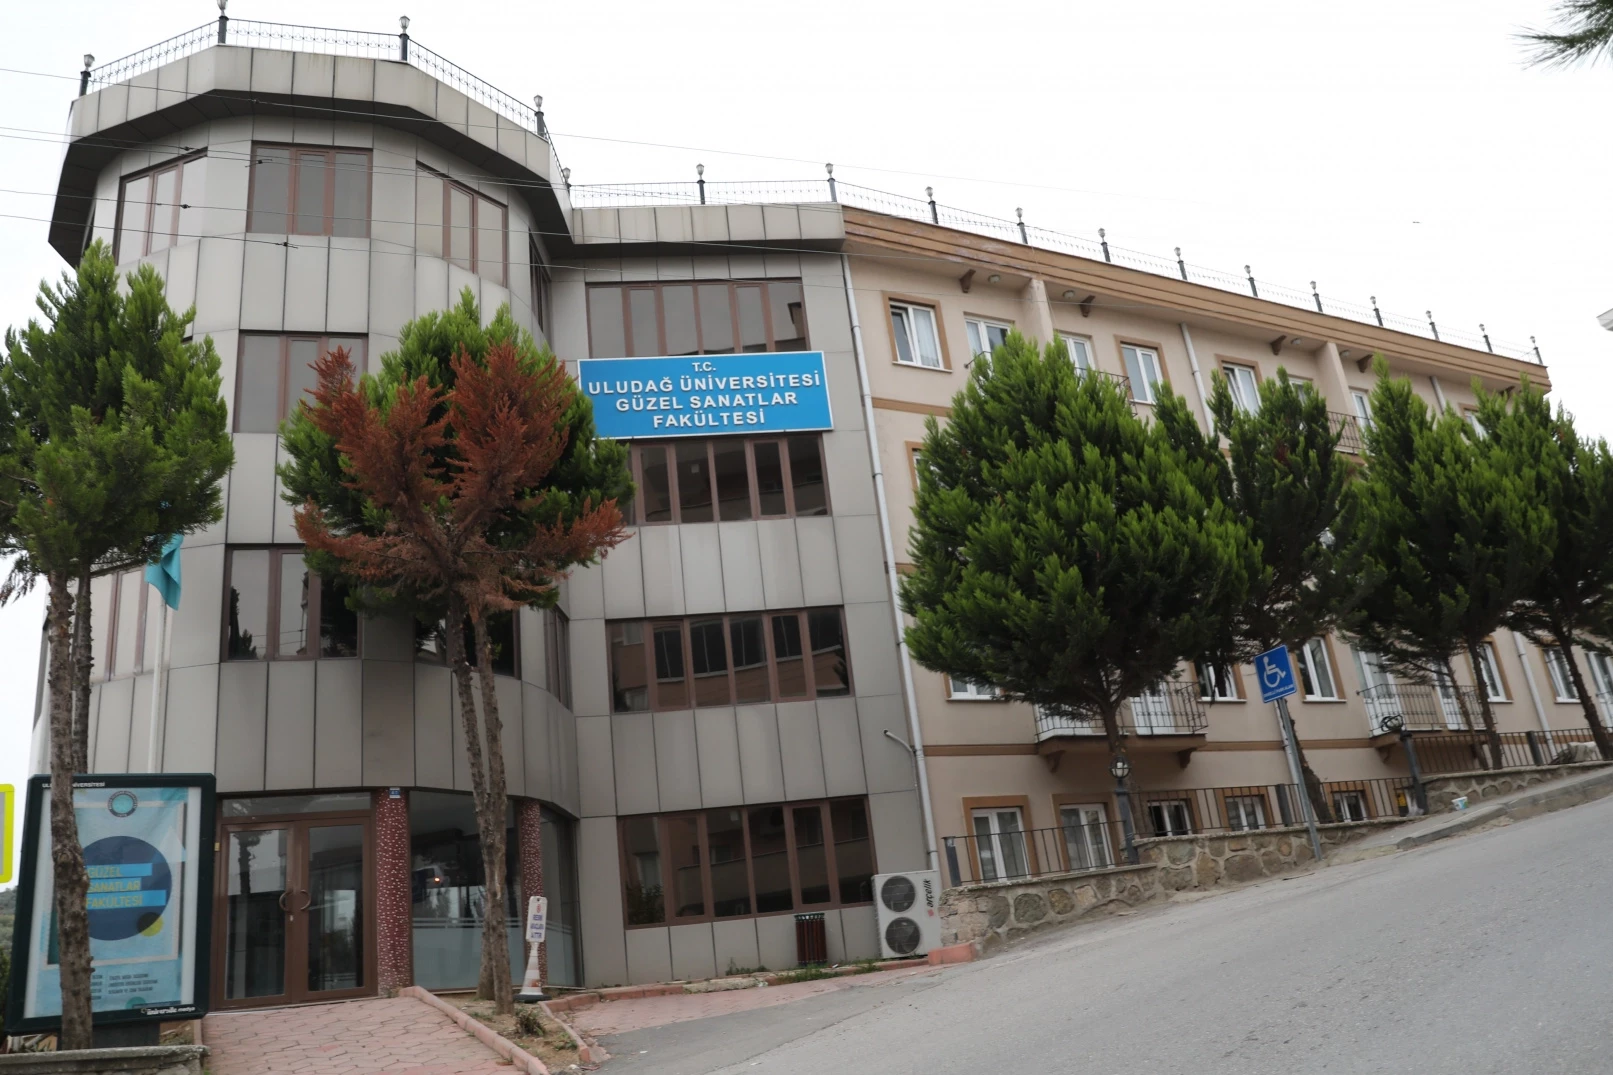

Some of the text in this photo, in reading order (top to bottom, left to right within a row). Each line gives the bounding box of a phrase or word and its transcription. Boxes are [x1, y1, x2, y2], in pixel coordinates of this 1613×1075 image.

[692, 361, 716, 372] T.C.
[588, 370, 821, 395] ULUDAĞ ÜNİVERSİTESİ
[615, 391, 798, 411] GÜZEL SANATLAR
[653, 408, 766, 429] FAKÜLTESİ
